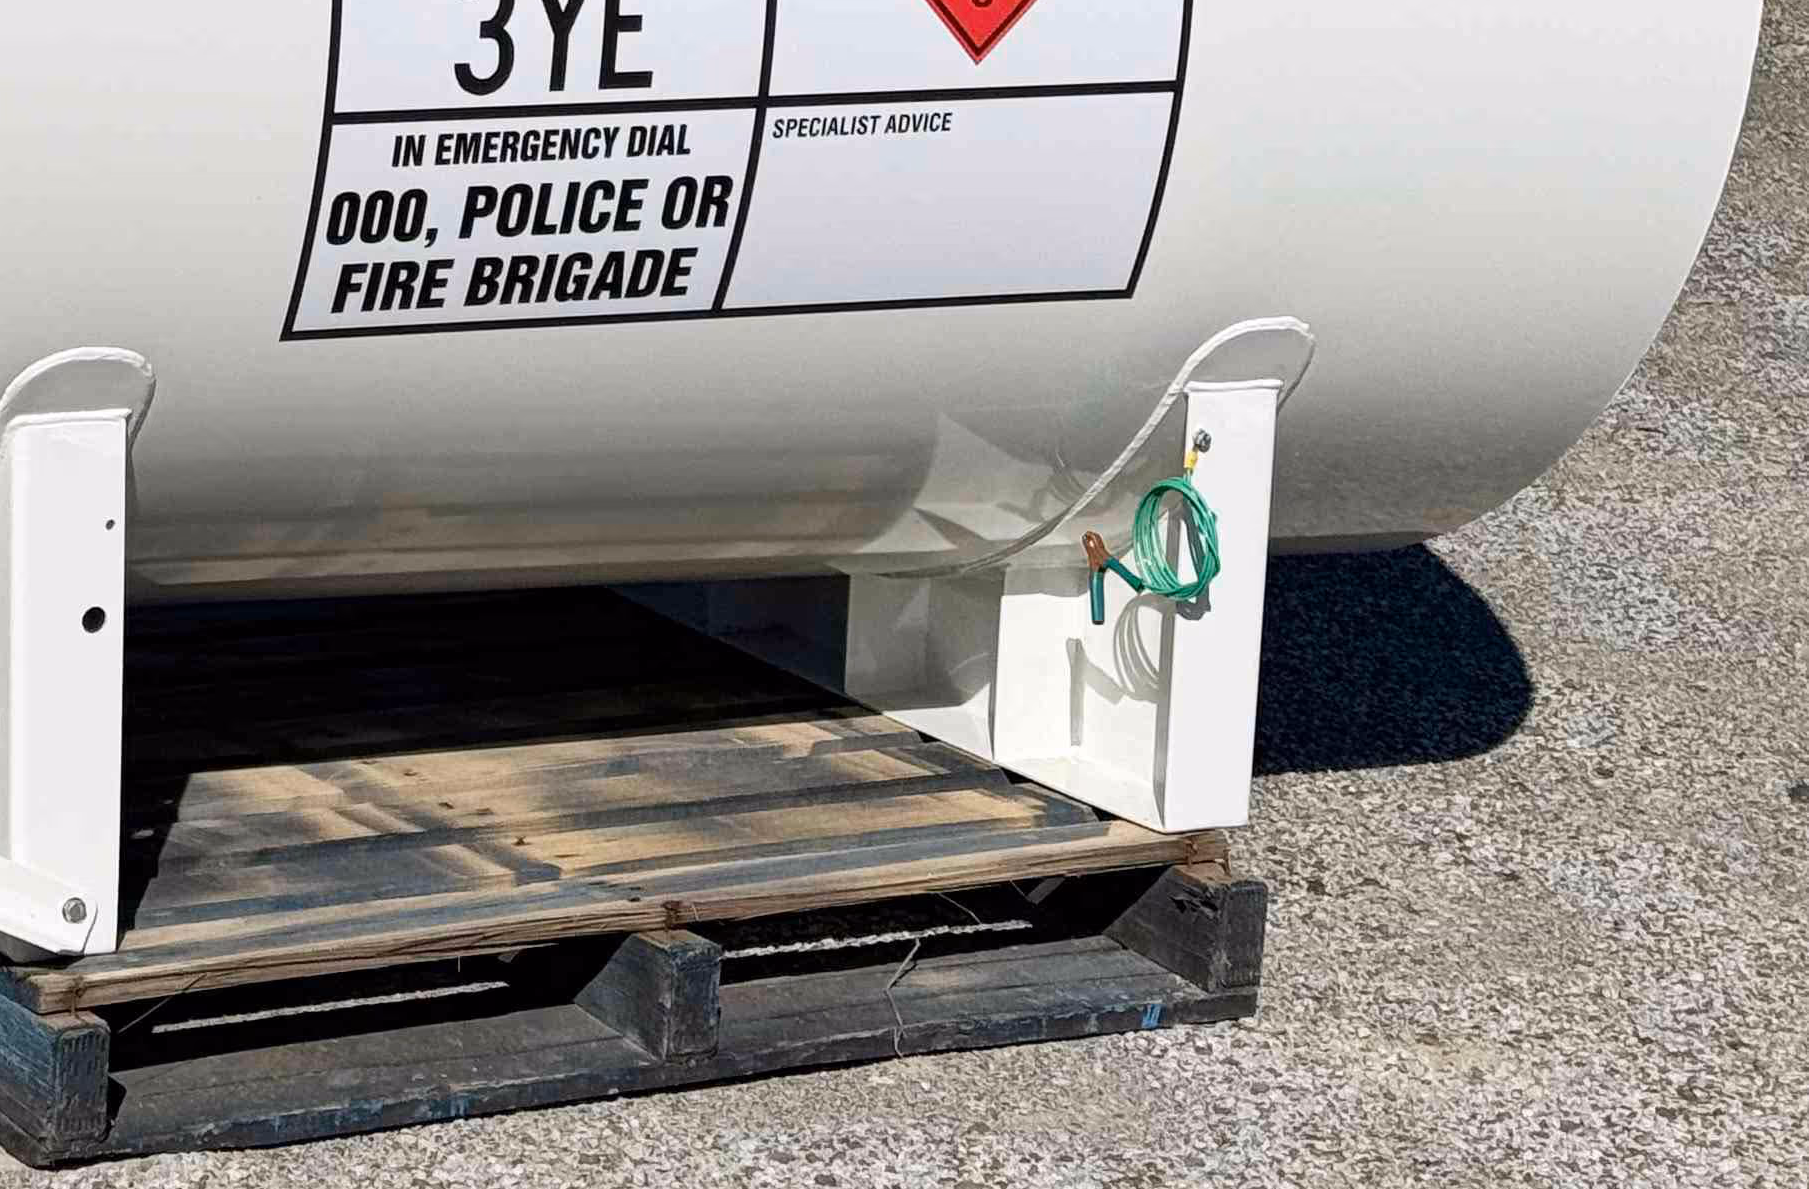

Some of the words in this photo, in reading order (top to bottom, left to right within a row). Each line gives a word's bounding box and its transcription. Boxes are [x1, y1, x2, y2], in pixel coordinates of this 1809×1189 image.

[391, 134, 427, 168] IN
[434, 126, 621, 166] EMERGENCY
[626, 123, 691, 158] DIAL
[771, 114, 883, 139] SPECIALIST
[883, 111, 954, 135] ADVICE
[325, 188, 439, 249] 000,
[458, 178, 650, 240] POLICE
[661, 174, 734, 230] OR
[330, 258, 456, 315] FIRE
[462, 246, 699, 307] BRIGADE
